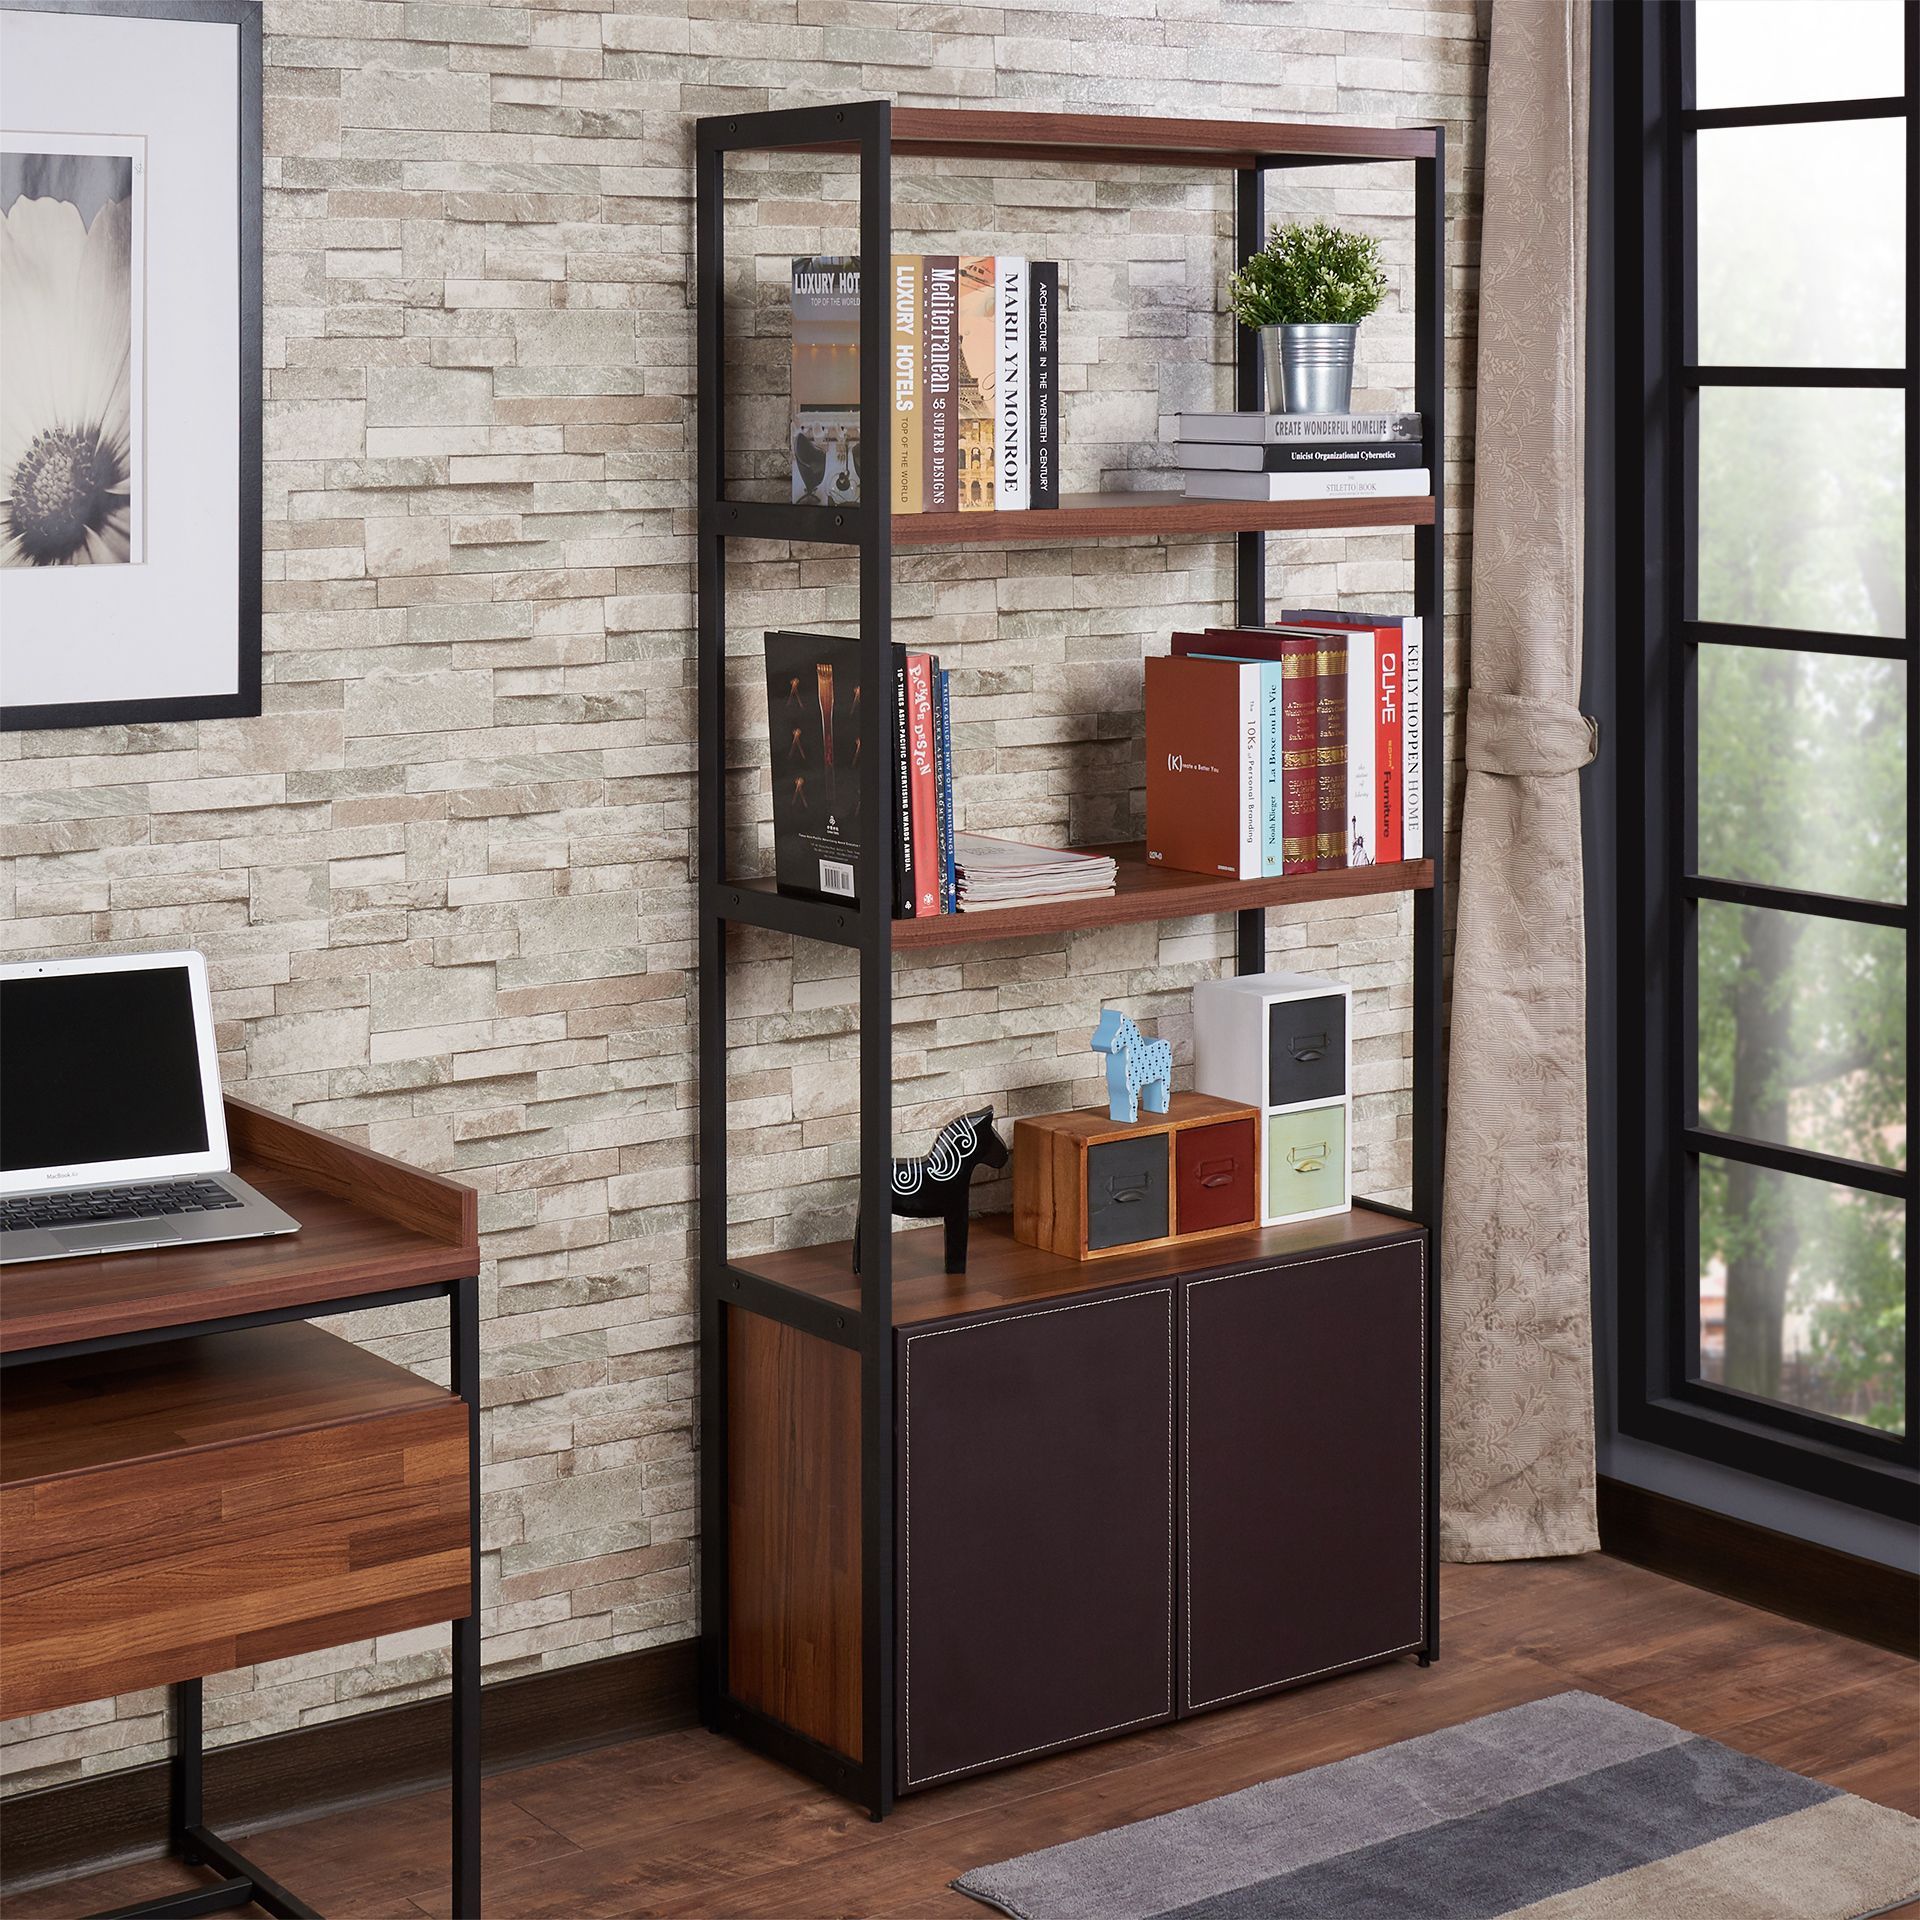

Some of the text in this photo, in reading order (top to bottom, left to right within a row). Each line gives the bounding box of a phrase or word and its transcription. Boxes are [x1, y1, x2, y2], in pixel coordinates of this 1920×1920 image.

[795, 272, 834, 294] LUXURY
[810, 298, 860, 306] TOP OF THE WORLD
[896, 266, 914, 411] LUXURY HOTELS
[930, 268, 956, 393] Mediterranean
[1004, 273, 1019, 492] MARILYN MONROE
[1039, 282, 1048, 492] ARCHITECTURE IN THE TWENTIETH CENTURY
[901, 436, 908, 448] OF
[1274, 420, 1387, 436] CREATE WONDERFUL HOMELIFE
[932, 398, 946, 504] 65 SUPERB DESIGNS
[1291, 450, 1396, 462] Unicist Organizational Cybernetics
[1326, 483, 1376, 492] STILETTO BOOK
[909, 664, 932, 776] PACKAGE DESIGN
[1269, 706, 1276, 716] la
[1248, 720, 1256, 750] 10Ks
[1270, 720, 1276, 734] ou
[1408, 644, 1419, 832] KELLY HOPPEN HOME
[900, 761, 908, 808] ADVERTISING
[1269, 768, 1276, 784] La
[1268, 796, 1277, 822] Klieger
[1383, 771, 1392, 838] Furniture
[902, 812, 910, 842] AWARDS
[1246, 804, 1255, 844] Branding
